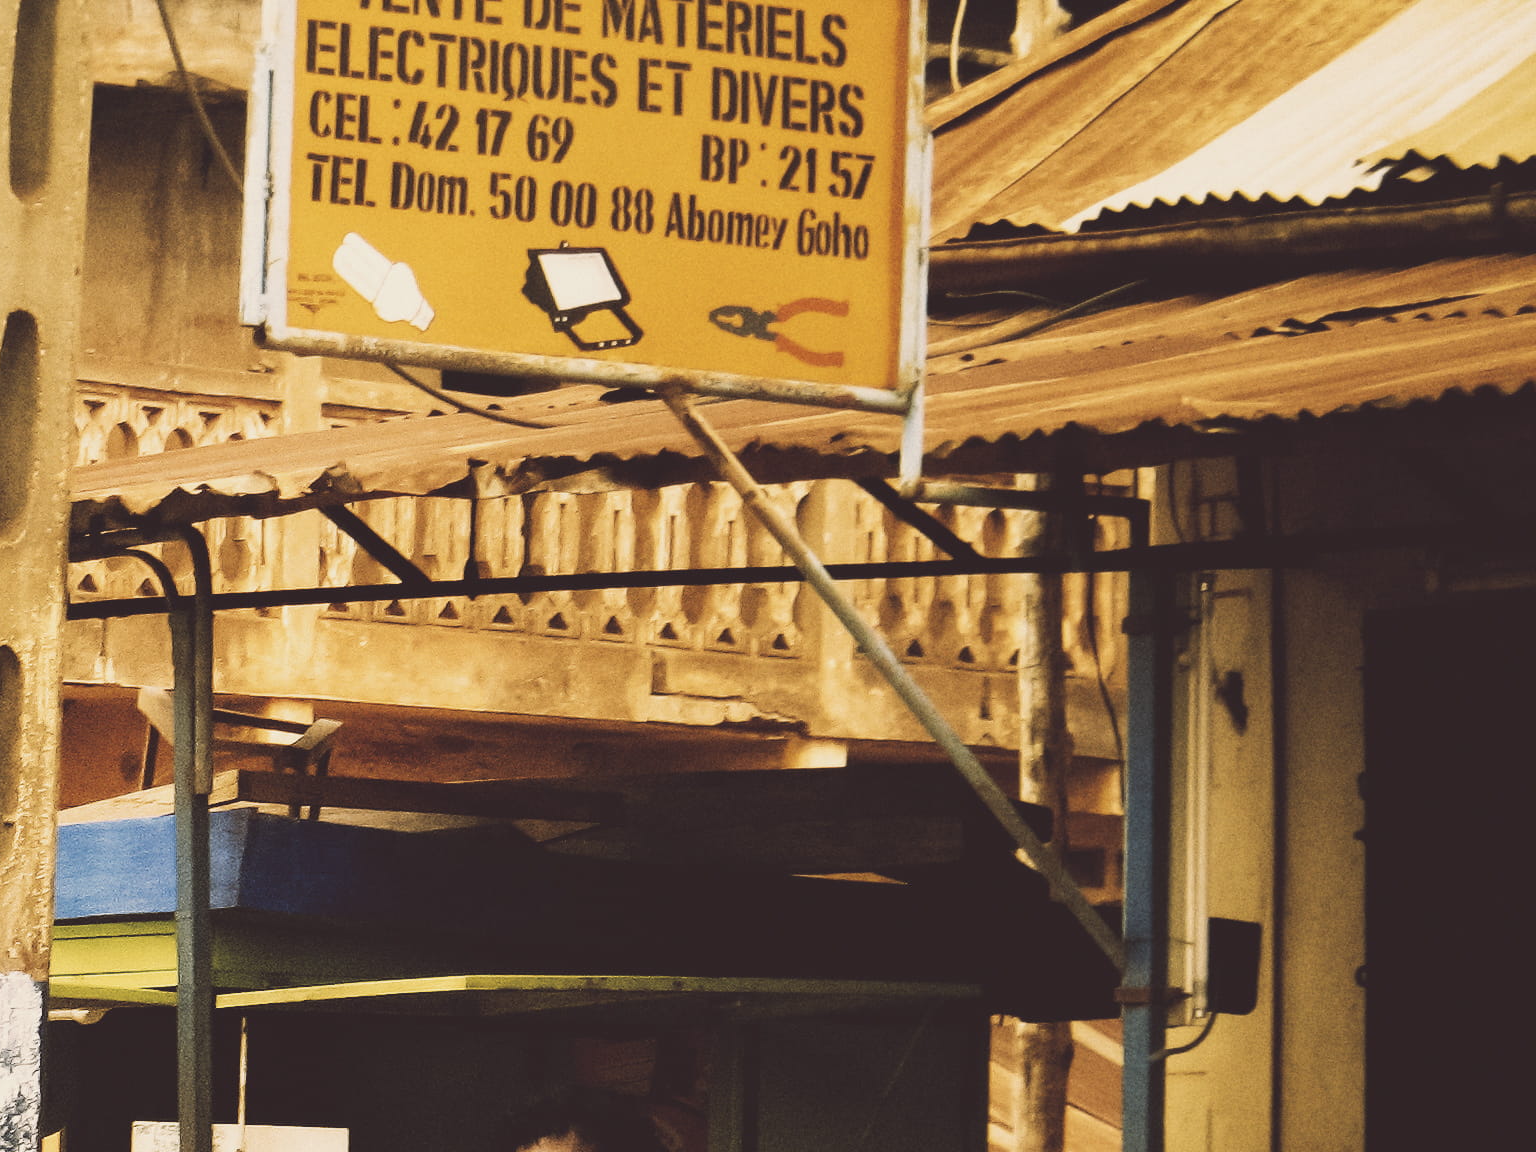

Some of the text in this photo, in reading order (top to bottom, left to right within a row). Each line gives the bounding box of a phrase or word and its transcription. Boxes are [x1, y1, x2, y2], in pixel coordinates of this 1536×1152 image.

[601, 0, 847, 68] MATERIELS
[306, 19, 864, 138] ELECTRIQUES ET DIVERS
[476, 108, 512, 156] 17
[526, 114, 574, 163] 69
[307, 152, 376, 207] TEL
[489, 172, 537, 222] 50
[550, 181, 597, 228] 00
[611, 186, 654, 234] 88
[665, 192, 788, 250] Abomey
[797, 209, 869, 260] Goho
